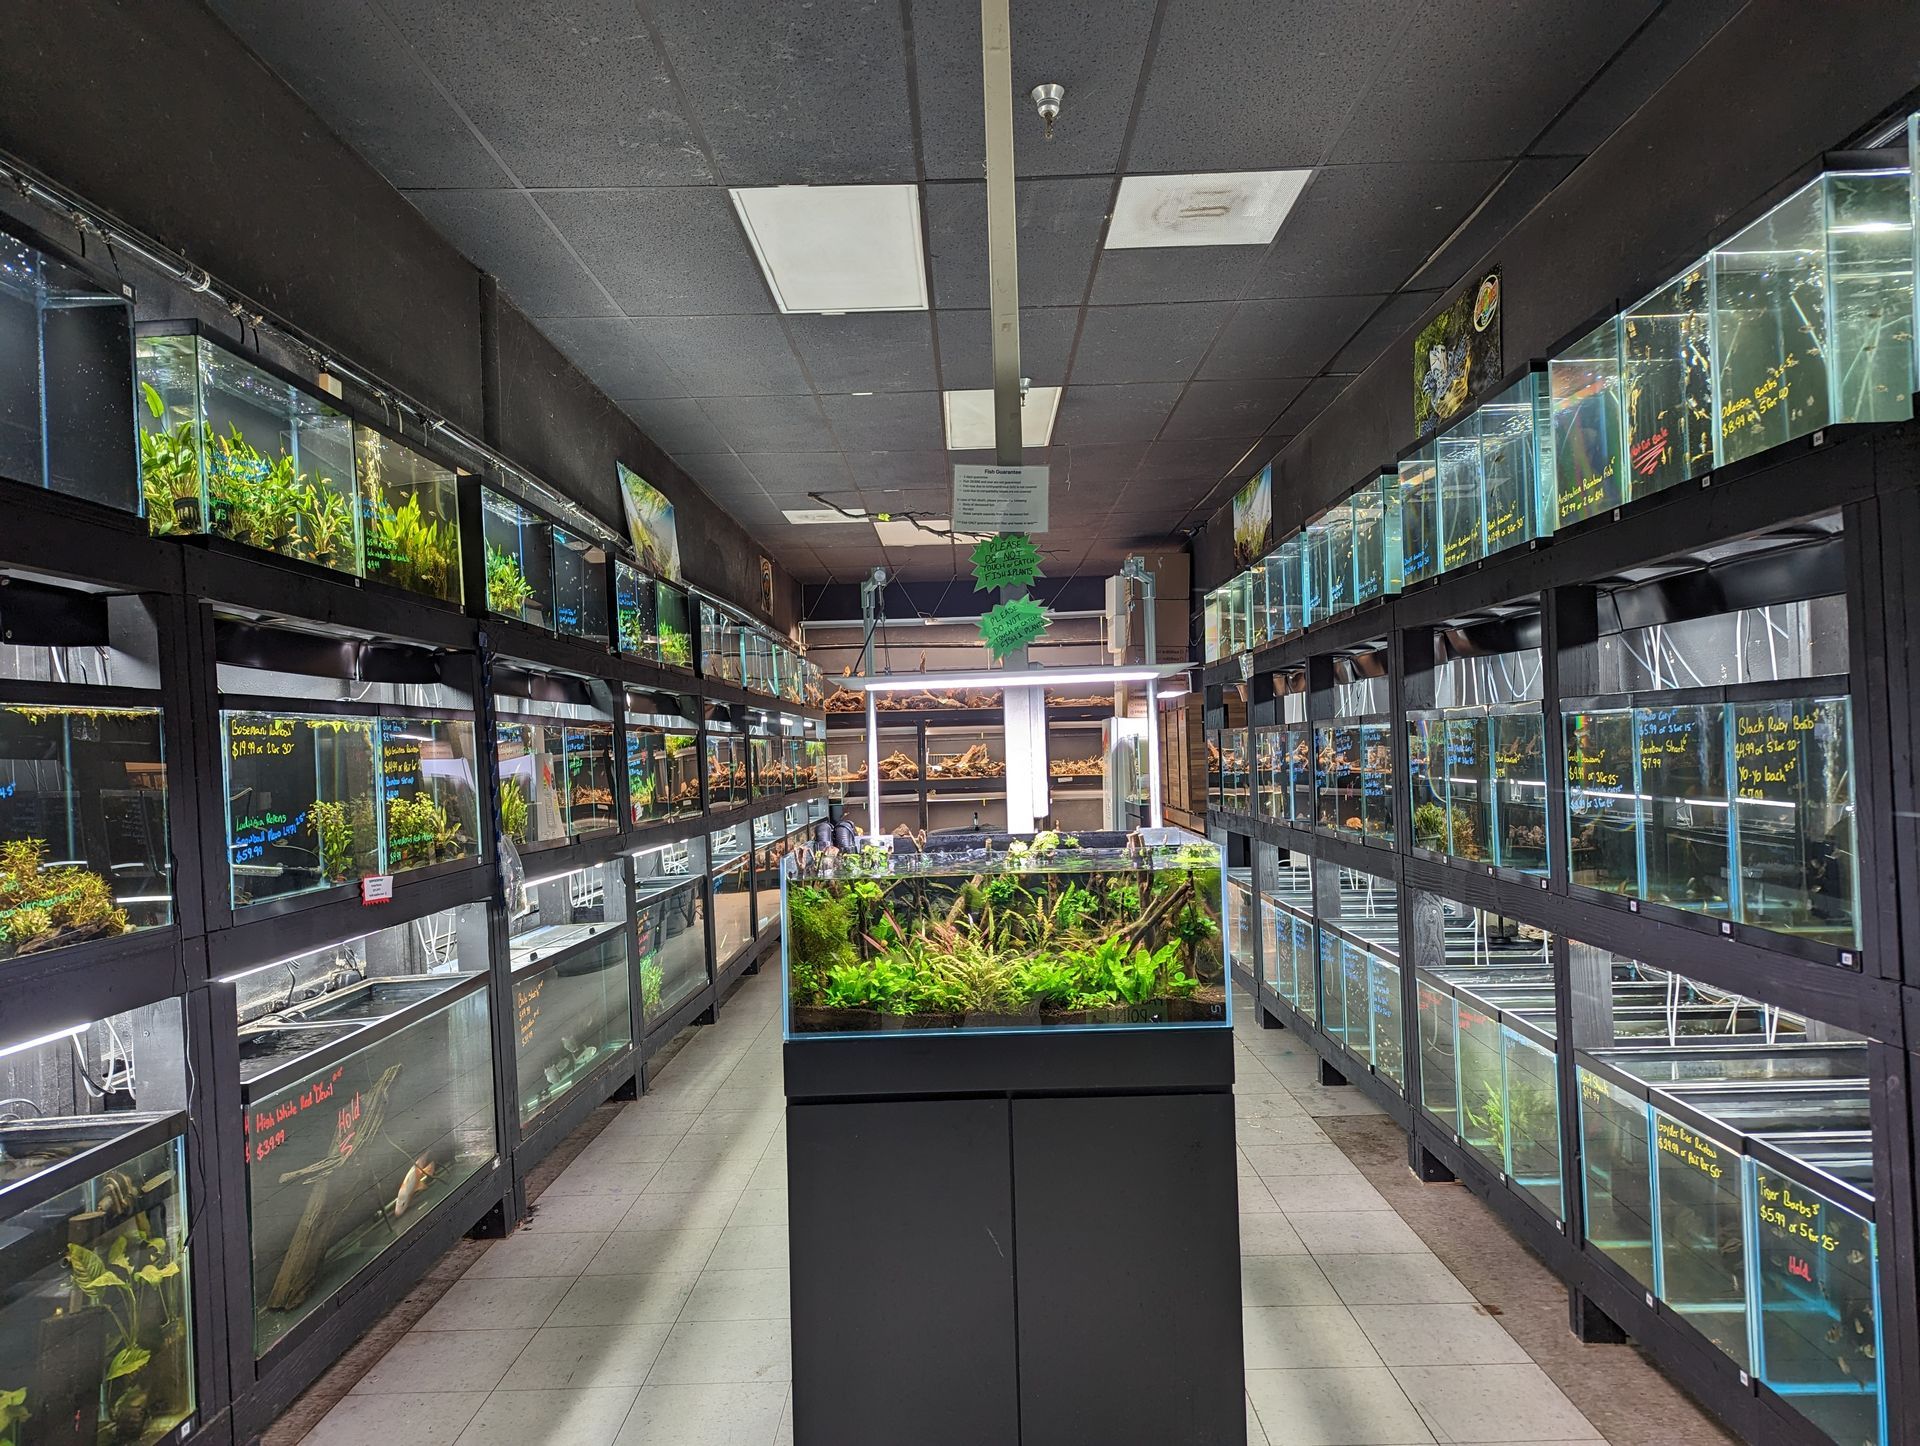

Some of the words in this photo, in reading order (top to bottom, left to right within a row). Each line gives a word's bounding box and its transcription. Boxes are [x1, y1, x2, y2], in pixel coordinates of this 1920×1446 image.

[1722, 398, 1752, 419] Odessa
[1722, 414, 1745, 439] $8.99
[1562, 502, 1576, 517] $7.99
[985, 554, 996, 564] DO
[1004, 550, 1023, 561] NOT
[990, 542, 1021, 552] PLEASE
[983, 562, 1005, 571] TOUCH
[1014, 558, 1035, 567] CATCH
[986, 572, 1006, 581] FISH
[1013, 568, 1033, 576] PLANTS
[991, 606, 1018, 626] PLEASE
[993, 625, 1005, 635] DO
[1008, 614, 1021, 626] NOT
[996, 630, 1013, 643] TOUCH
[1021, 616, 1038, 626] CATCH
[1001, 636, 1017, 648] FISH
[1024, 621, 1044, 634] PLANTS
[1640, 724, 1657, 736] $5.99
[1739, 717, 1764, 736] Black
[1768, 716, 1788, 734] Ruby
[232, 741, 255, 760] $19.99
[256, 746, 263, 754] or
[1666, 740, 1686, 753] Shark
[1735, 742, 1755, 761] $4.99
[1642, 757, 1661, 771] $7.99
[236, 846, 263, 864] $59.99
[256, 1112, 275, 1133] High
[276, 1101, 297, 1122] White
[300, 1092, 313, 1110] Red
[338, 1092, 362, 1137] Hold
[256, 1130, 285, 1161] $39.99
[1658, 1136, 1679, 1154] $29.99
[1758, 1176, 1779, 1200] Tiger
[1784, 1190, 1812, 1218] Barbs
[1761, 1204, 1786, 1228] $5.99
[1789, 1224, 1798, 1233] or
[1789, 1256, 1812, 1282] Hold
